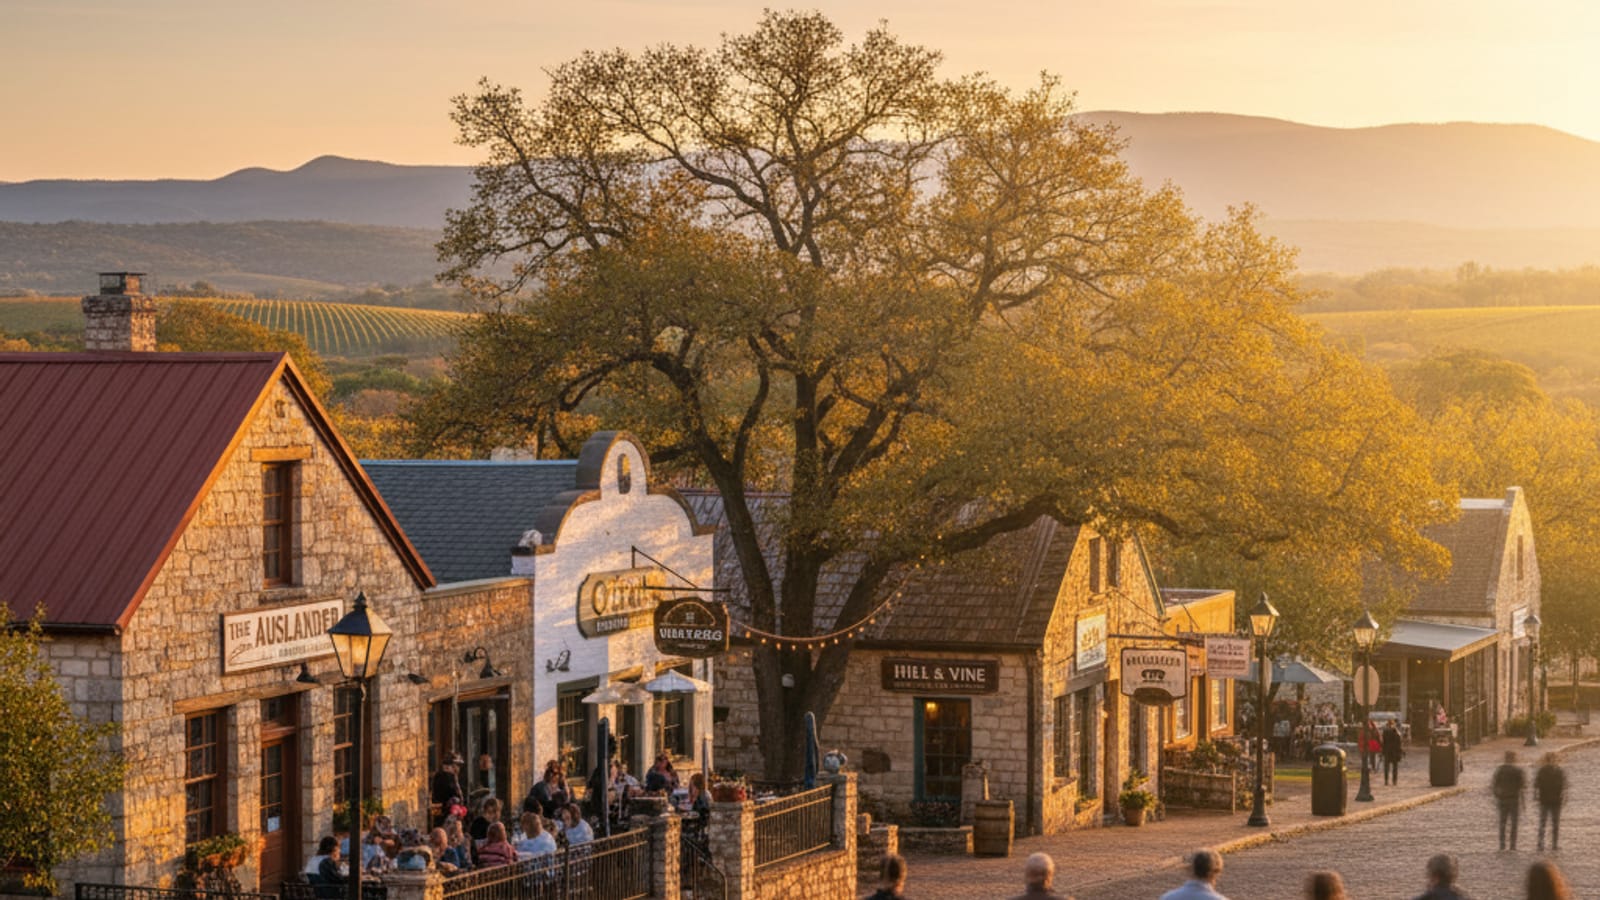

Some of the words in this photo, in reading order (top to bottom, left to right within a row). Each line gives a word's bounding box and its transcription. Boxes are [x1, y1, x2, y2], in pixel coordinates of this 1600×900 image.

[228, 620, 251, 640] THE
[255, 607, 339, 647] AUSLANDER
[934, 667, 944, 680] &
[948, 667, 986, 682] VINE
